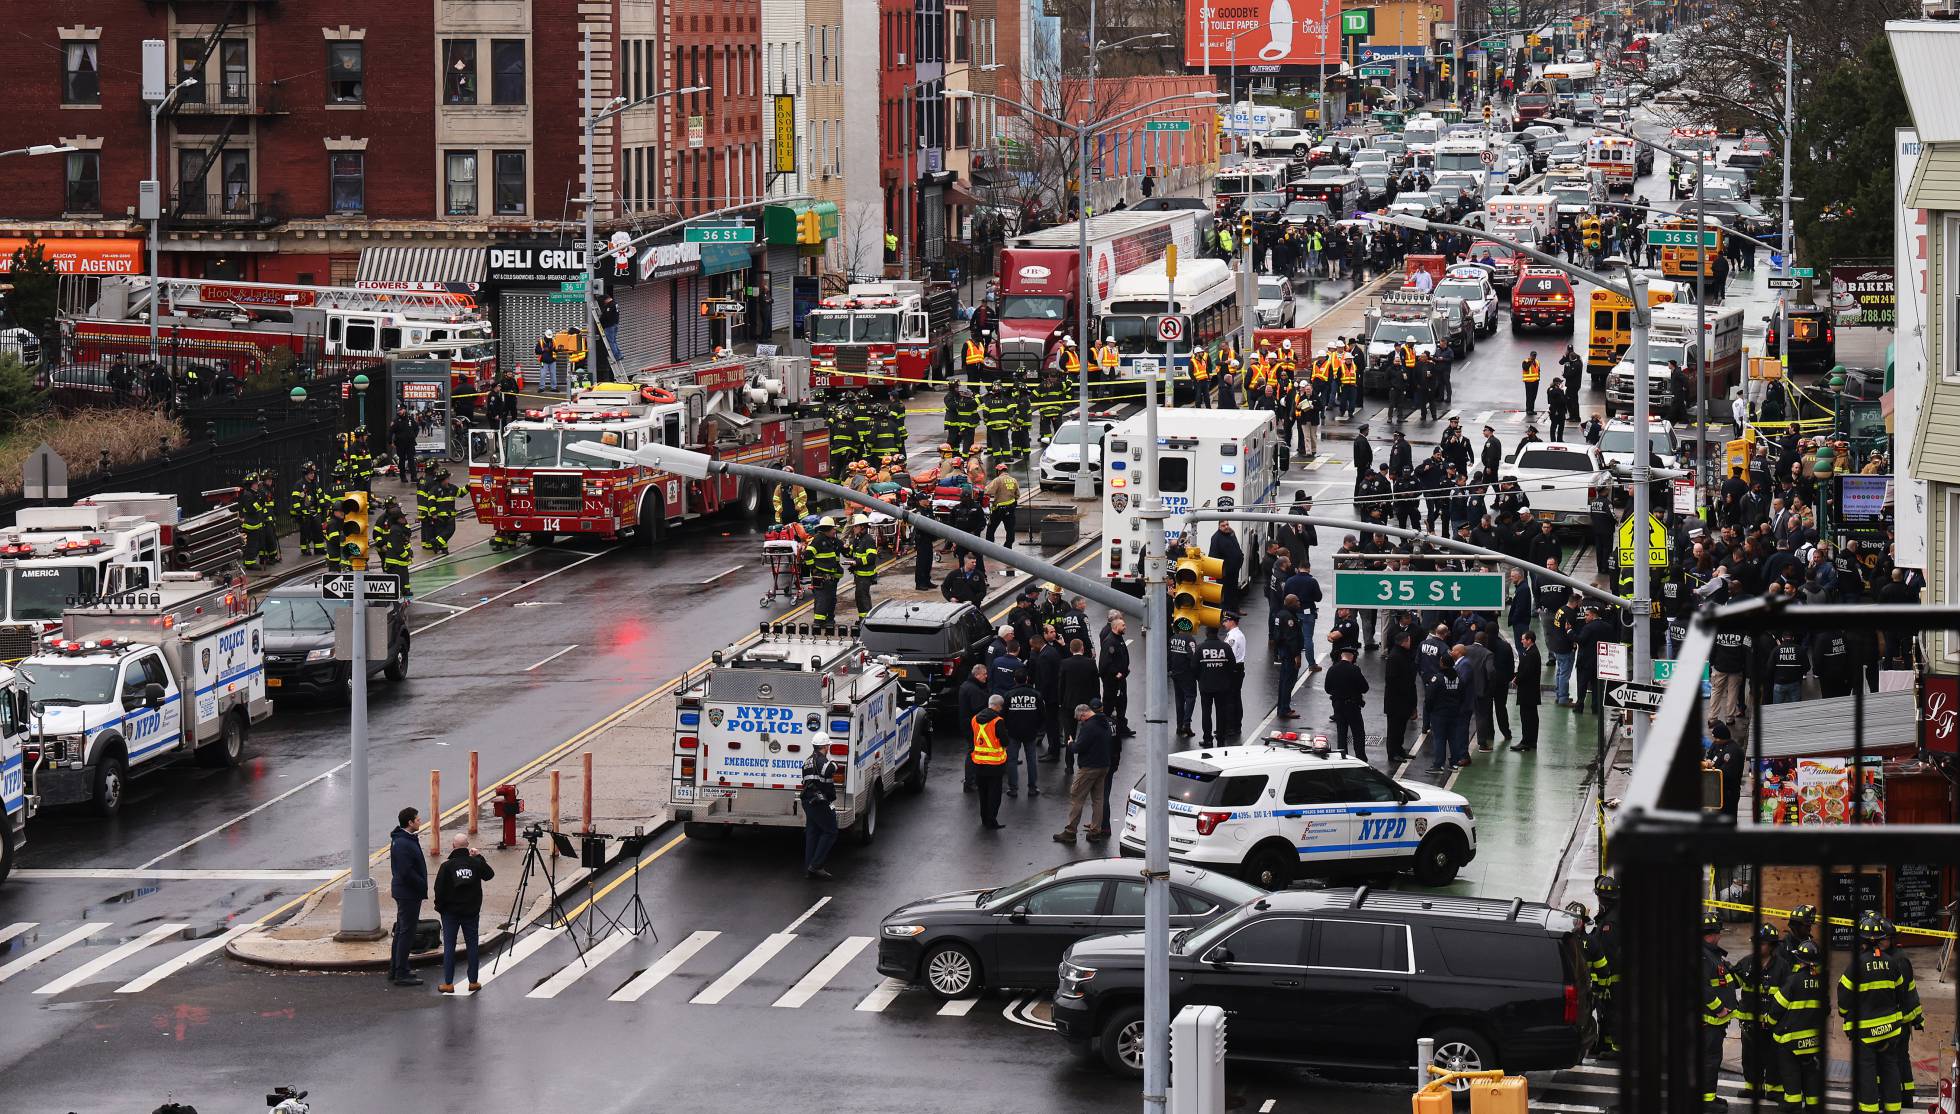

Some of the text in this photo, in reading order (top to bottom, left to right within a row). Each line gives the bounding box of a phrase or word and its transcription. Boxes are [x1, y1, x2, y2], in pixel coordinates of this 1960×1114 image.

[1200, 8, 1259, 18] SAY GOODBYE
[1211, 21, 1259, 30] TOILET PAPER
[1345, 15, 1365, 30] TD
[1373, 52, 1415, 60] Domino's
[777, 97, 785, 170] PROSPERITY
[785, 112, 793, 157] NOODLE
[703, 231, 738, 240] 36 St
[1665, 234, 1680, 242] 36
[490, 249, 532, 269] DELI
[81, 259, 132, 272] AGENCY
[1538, 280, 1552, 290] 48
[208, 287, 234, 298] Hook
[1521, 297, 1538, 305] FDNY
[1861, 295, 1880, 303] OPEN
[1881, 295, 1889, 303] 24
[815, 377, 830, 386] 201
[511, 500, 533, 509] F.D.
[543, 518, 560, 531] 114
[1861, 540, 1886, 550] Street
[1622, 552, 1665, 561] SCOL
[22, 569, 60, 578] AMERICA
[331, 582, 393, 593] ONE WAY
[1377, 580, 1462, 602] 35 St
[1541, 585, 1562, 593] POLICE
[219, 629, 245, 654] POLICE
[1171, 639, 1186, 647] NYPD
[1832, 638, 1844, 646] STATE
[1202, 649, 1226, 659] PBA
[1421, 643, 1438, 656] NYPD
[1010, 695, 1036, 704] NYPD
[1617, 689, 1664, 705] ONE WA
[737, 706, 794, 721] NYPD
[135, 712, 161, 740] NYPD
[727, 719, 803, 735] POLICE
[724, 757, 804, 770] EMERGENCY SERVICE
[1812, 764, 1843, 776] Familia
[4, 768, 22, 797] NYPD
[677, 789, 693, 797] 5751
[1167, 801, 1193, 812] POLICE
[1358, 817, 1407, 841] NYPD
[456, 869, 473, 877] NYPD
[1870, 1024, 1893, 1037] INGRAM
